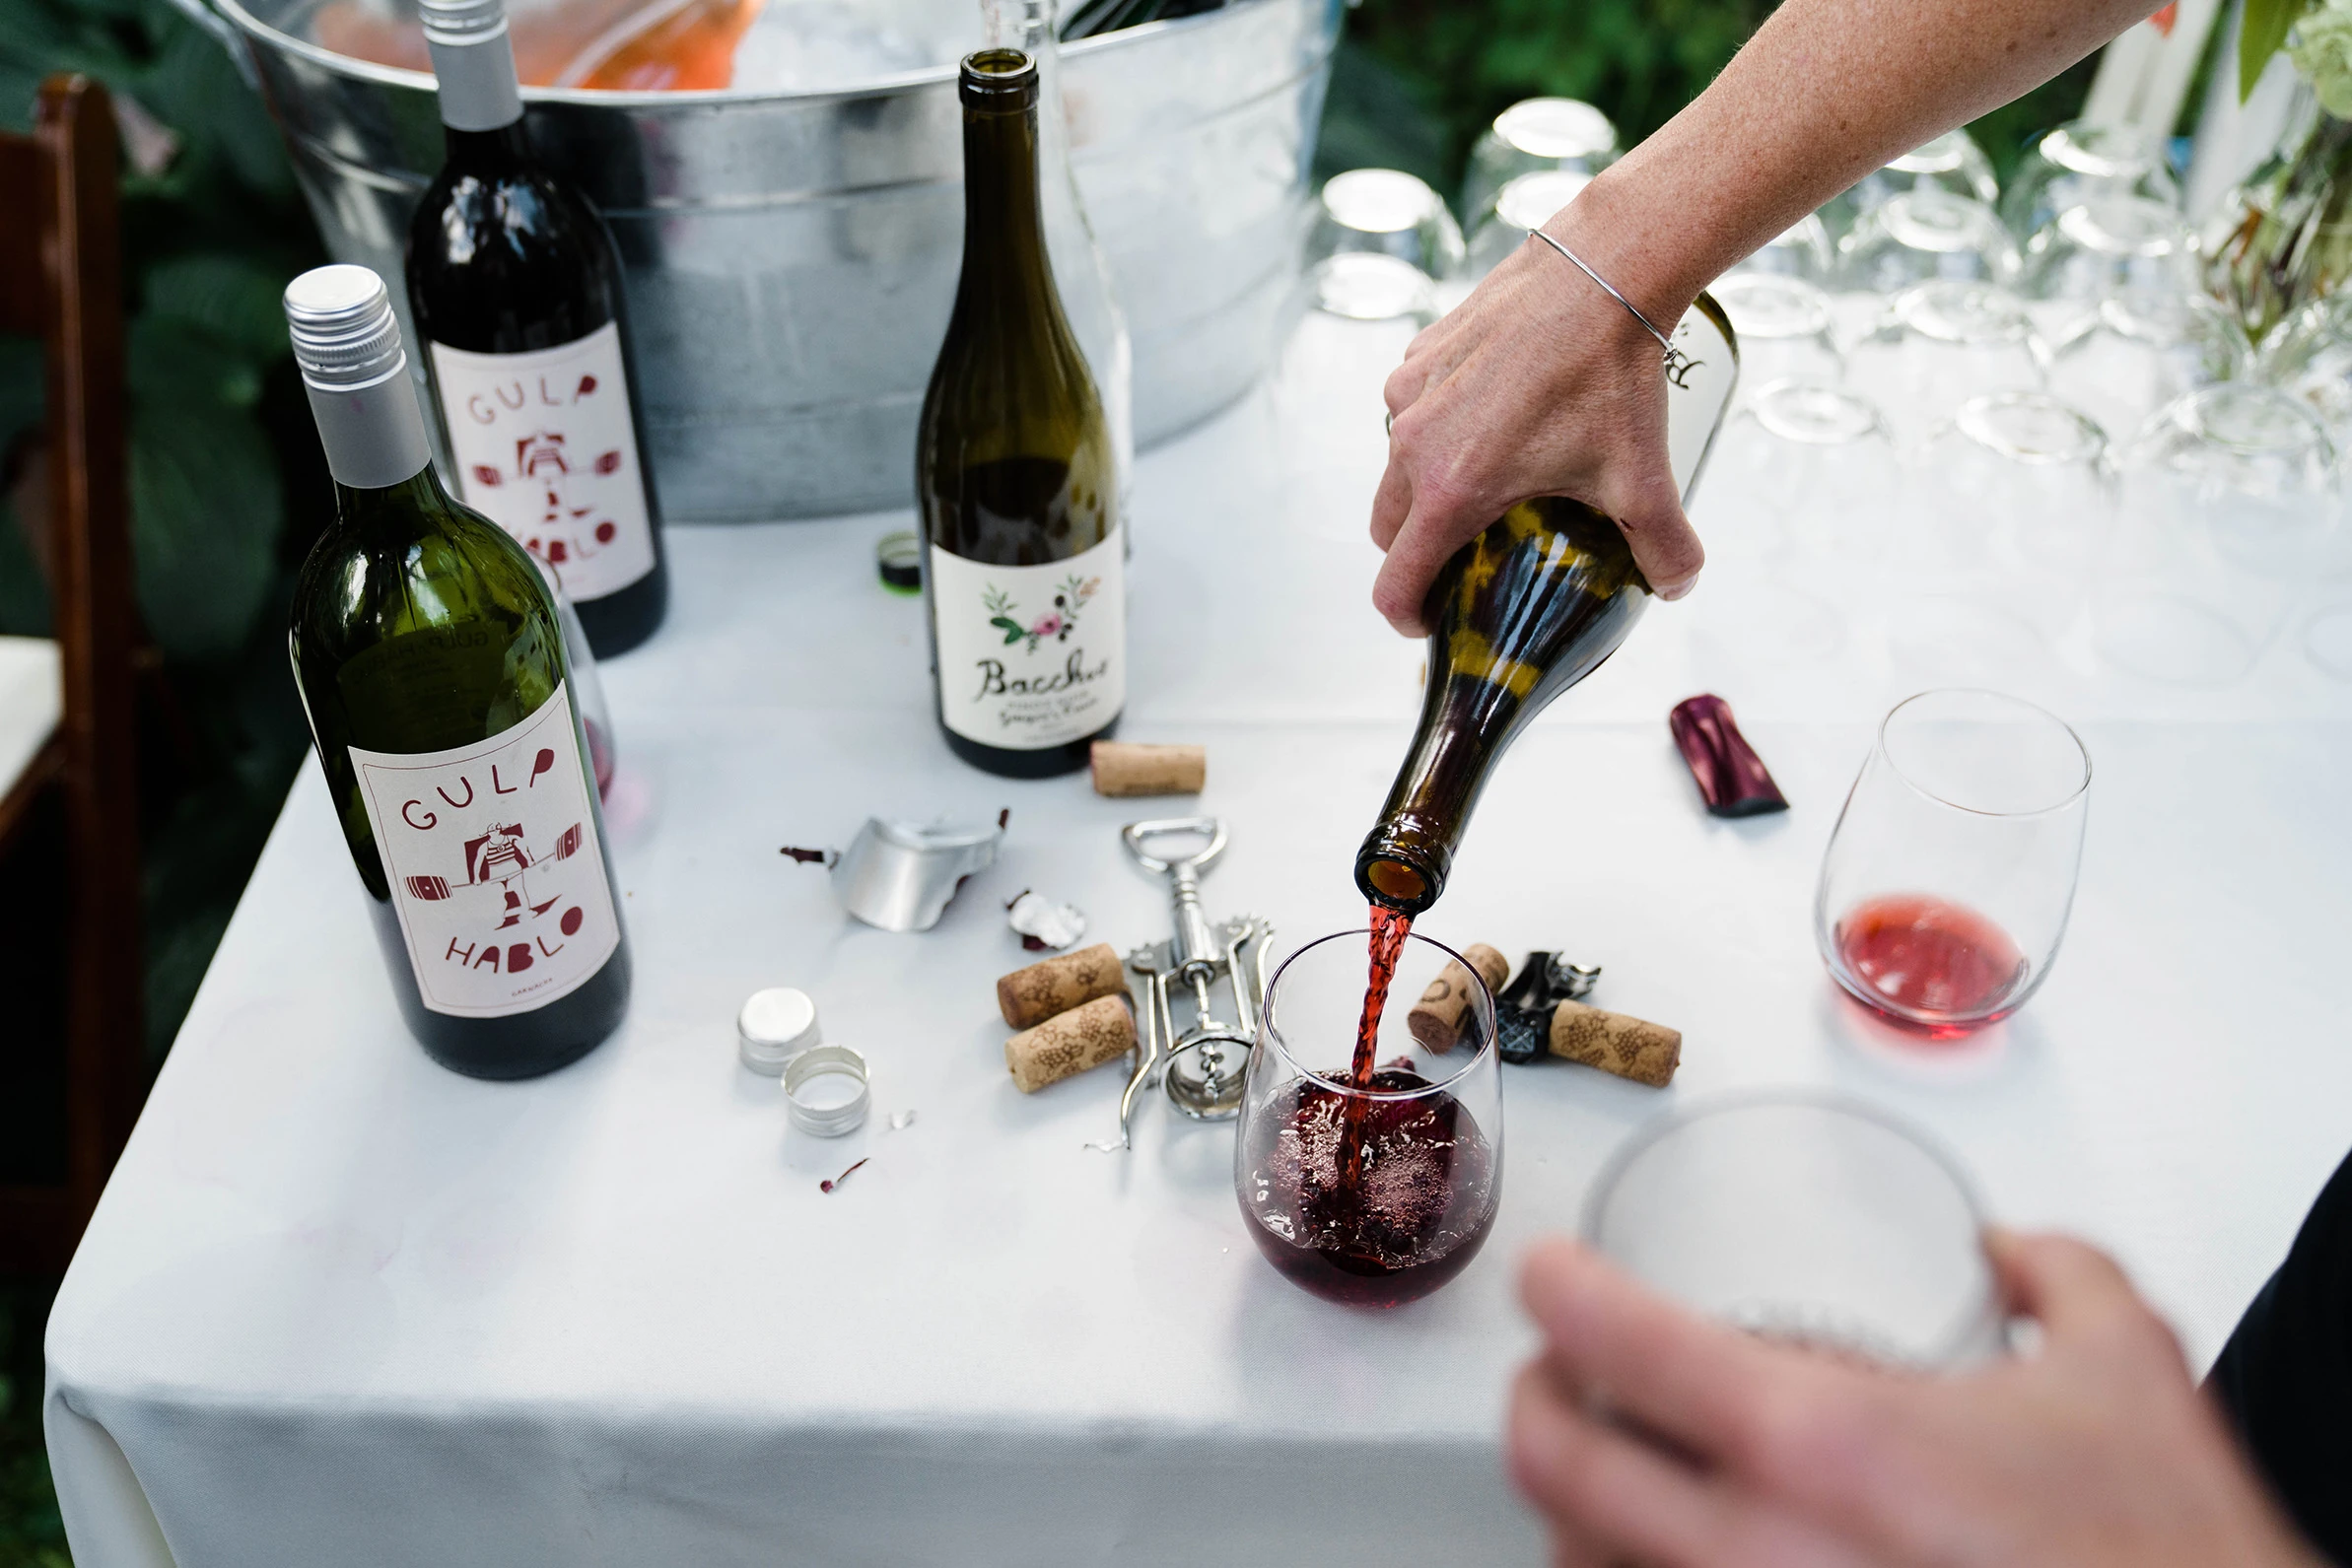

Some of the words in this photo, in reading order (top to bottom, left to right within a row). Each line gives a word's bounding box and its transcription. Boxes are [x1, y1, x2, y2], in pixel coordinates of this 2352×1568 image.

[467, 375, 598, 425] GULP
[504, 521, 616, 564] ABLO
[401, 748, 555, 830] GULP
[445, 905, 584, 975] HABLO
